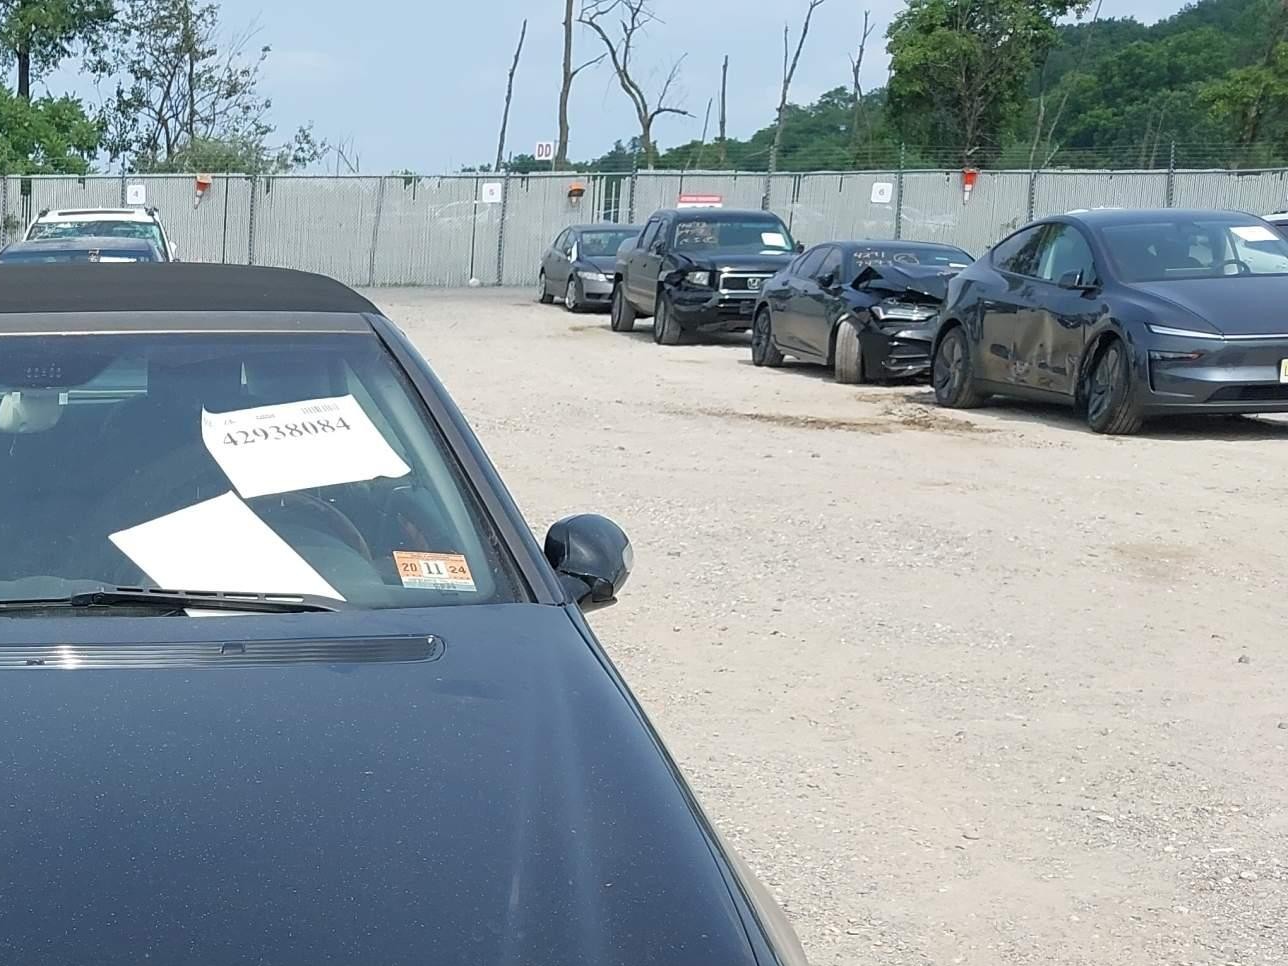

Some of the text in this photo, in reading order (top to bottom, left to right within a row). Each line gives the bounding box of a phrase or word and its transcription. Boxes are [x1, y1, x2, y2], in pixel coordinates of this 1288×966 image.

[537, 144, 552, 158] DD
[223, 416, 353, 447] 42938084
[401, 562, 466, 576] 20 11 24
